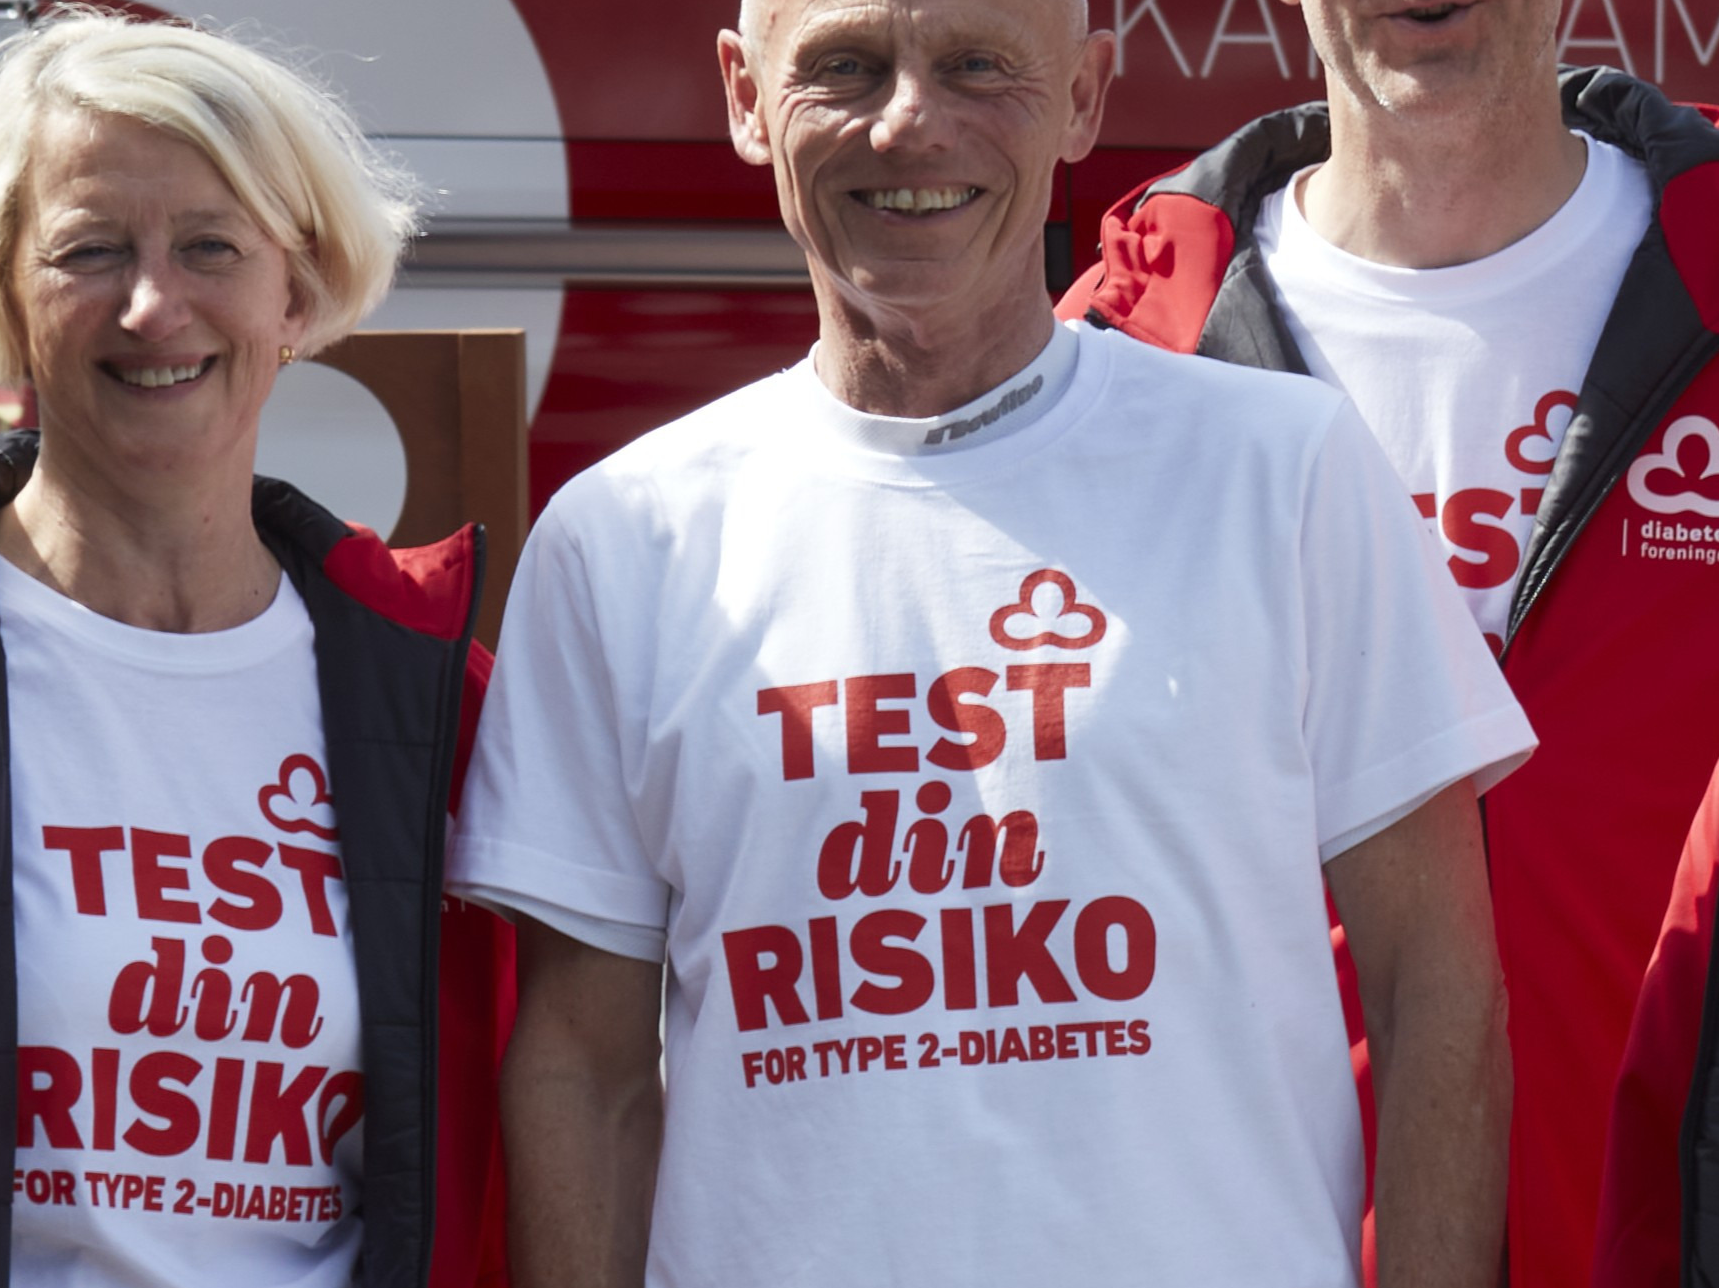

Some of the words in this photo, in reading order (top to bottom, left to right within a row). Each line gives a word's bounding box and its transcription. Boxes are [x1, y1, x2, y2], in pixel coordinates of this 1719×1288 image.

[757, 662, 1091, 781] TEST
[42, 825, 344, 937] TEST
[817, 781, 1044, 900] din
[108, 934, 324, 1049] din
[721, 895, 1157, 1032] RISIKO
[742, 1048, 806, 1088] FOR
[815, 1033, 908, 1079] TYPE
[917, 1019, 1152, 1069] 2-DIABETES
[12, 1169, 77, 1206] FOR
[85, 1171, 164, 1212] TYPE
[173, 1178, 342, 1223] 2-DIABETES
